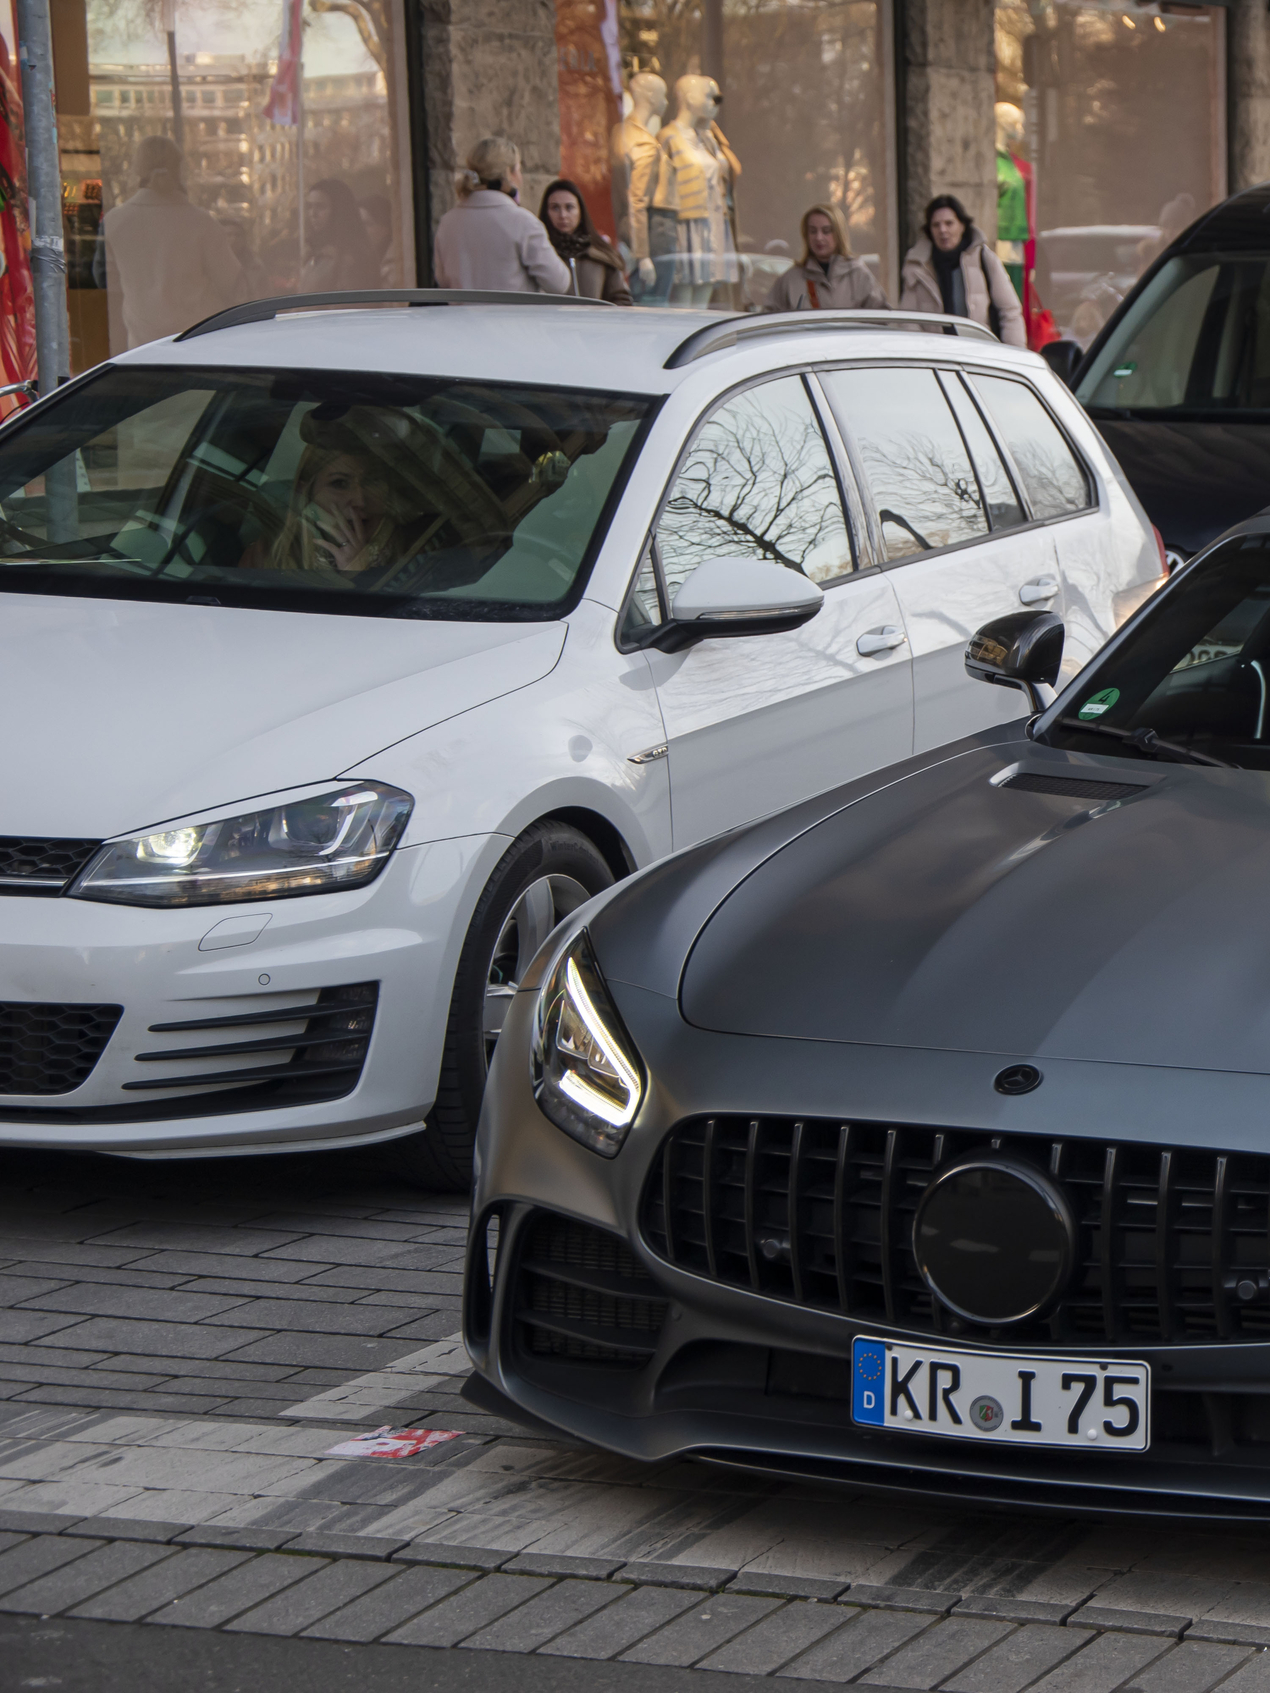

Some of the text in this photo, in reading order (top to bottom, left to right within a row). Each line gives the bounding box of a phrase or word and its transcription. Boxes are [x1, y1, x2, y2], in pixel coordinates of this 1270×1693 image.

[1098, 688, 1115, 704] 4
[862, 1389, 876, 1409] D
[889, 1354, 964, 1426] KR
[1009, 1368, 1043, 1433] I
[1060, 1371, 1141, 1438] 75
